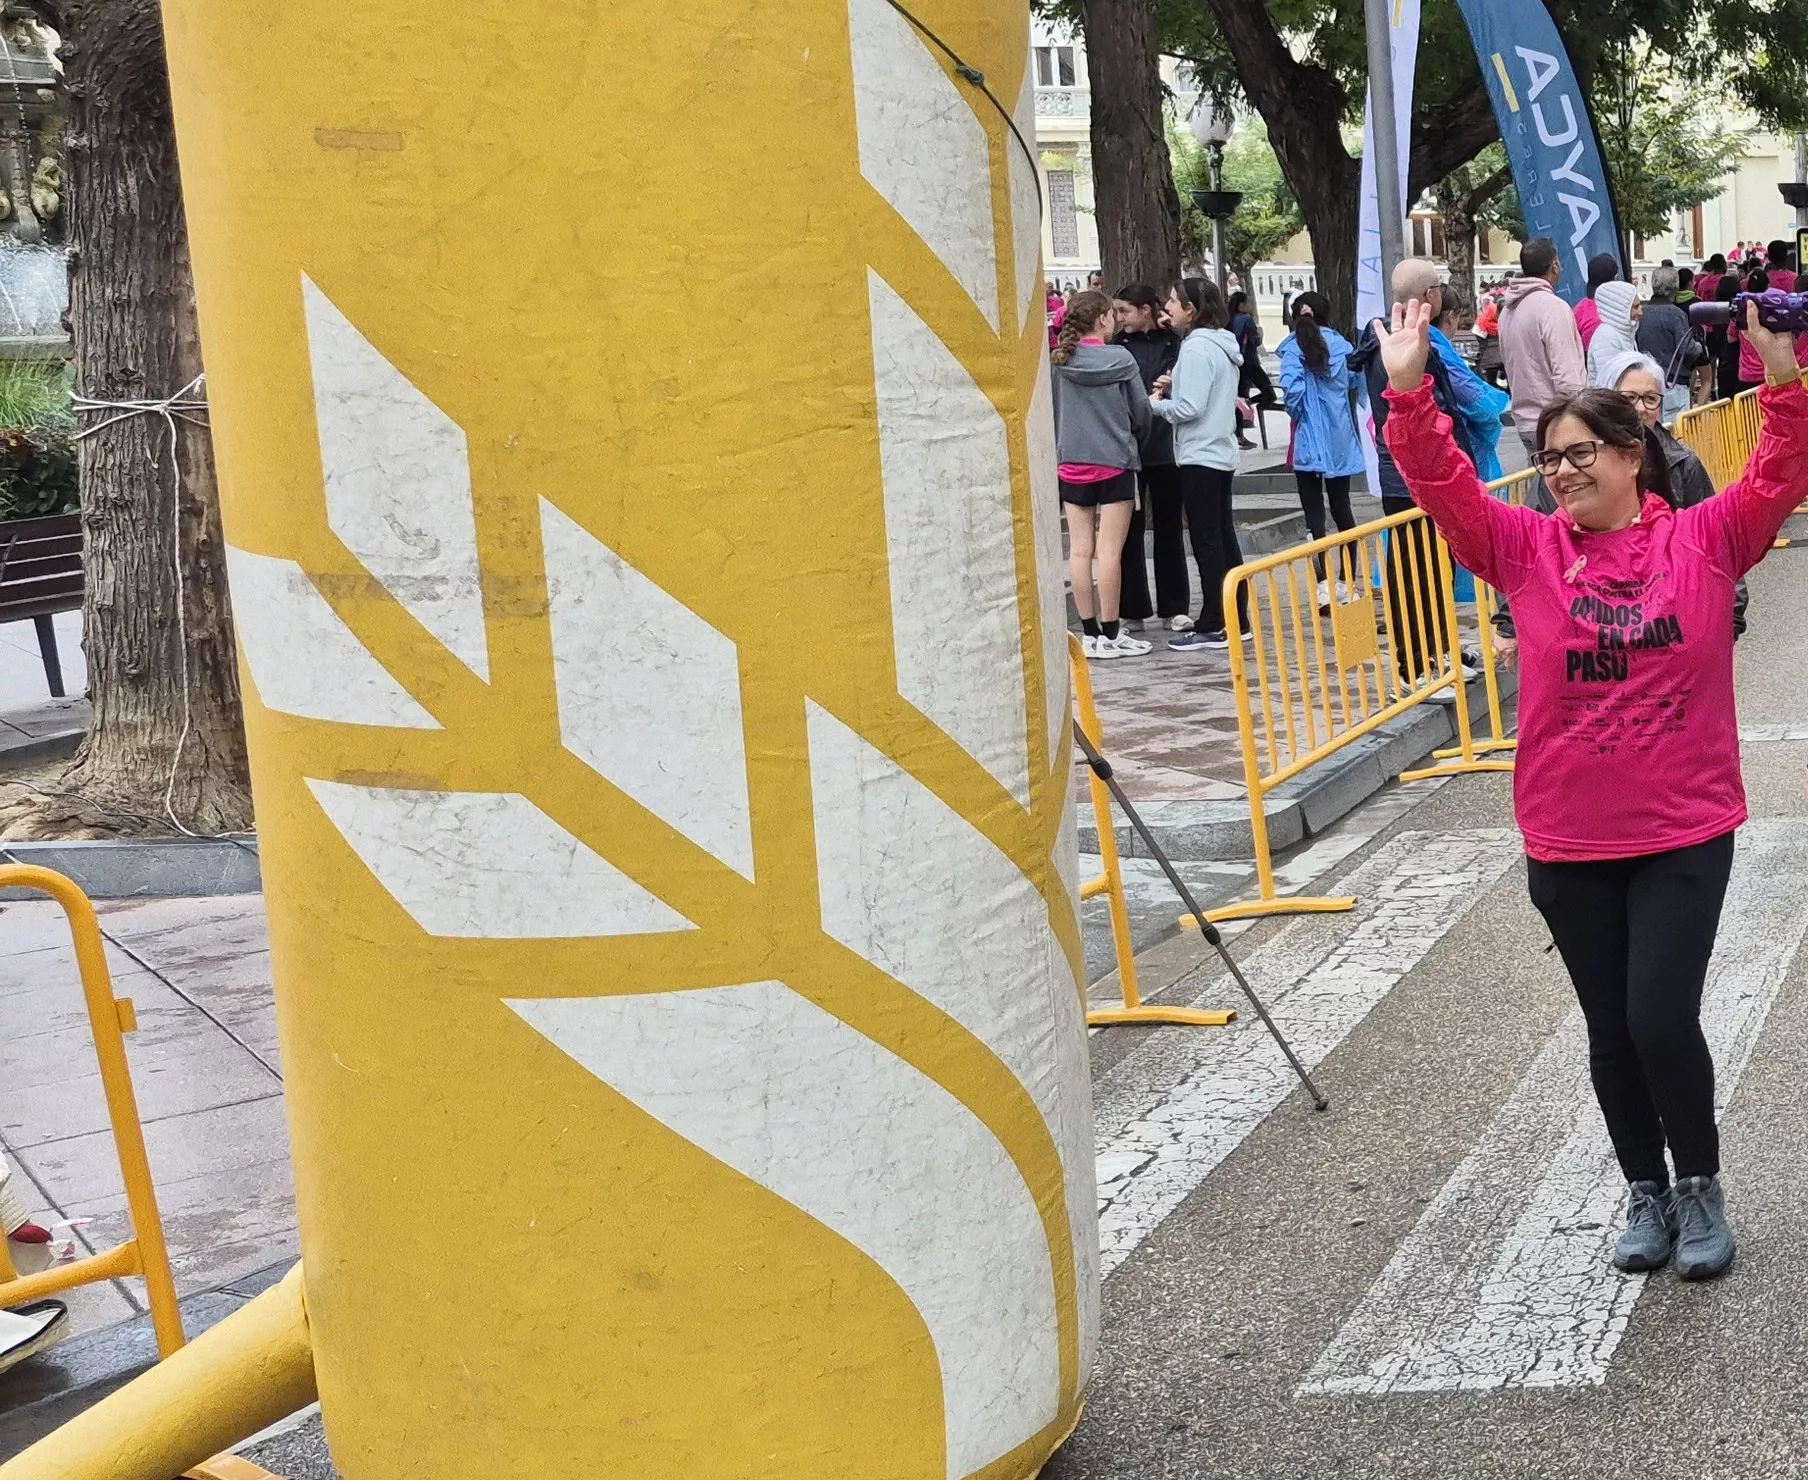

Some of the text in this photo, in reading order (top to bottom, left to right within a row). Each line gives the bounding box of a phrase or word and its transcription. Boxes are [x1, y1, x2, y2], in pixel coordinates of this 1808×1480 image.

[1570, 595, 1643, 627] UNIDOS
[1597, 614, 1684, 650] EN CADA
[1566, 649, 1628, 681] PASO
